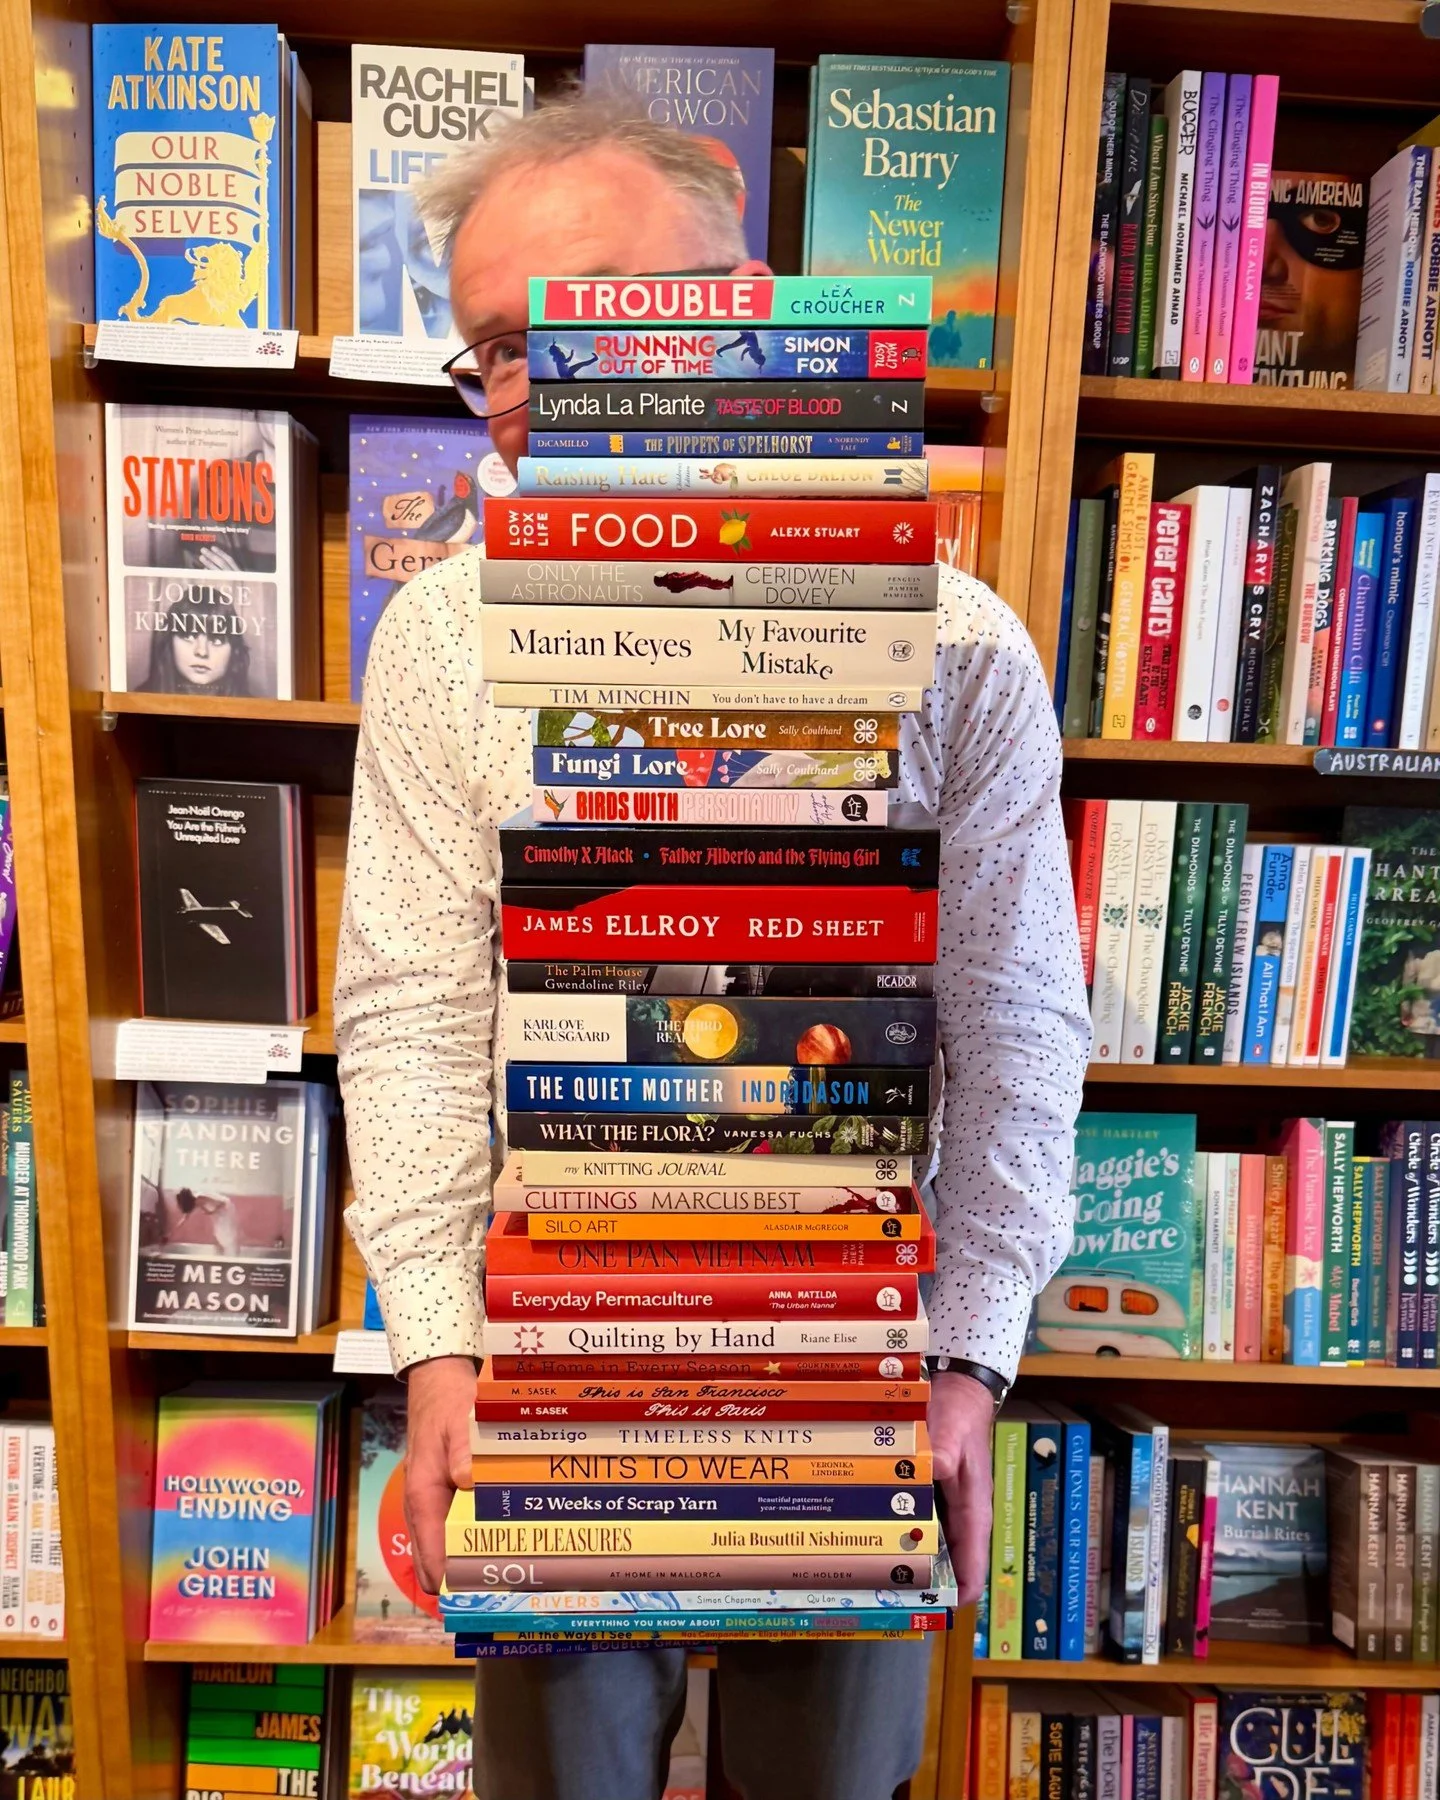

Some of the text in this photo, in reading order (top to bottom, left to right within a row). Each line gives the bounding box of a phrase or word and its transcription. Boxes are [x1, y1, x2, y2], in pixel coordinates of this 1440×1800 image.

[144, 36, 224, 72] KATE
[108, 75, 260, 111] ATKINSON
[359, 64, 518, 107] RACHEL
[828, 88, 996, 133] Sebastian
[383, 103, 493, 142] CUSK
[152, 136, 219, 160] OUR
[863, 138, 959, 190] Barry
[136, 172, 237, 198] NOBLE
[1247, 163, 1269, 229] IN BLOOM
[895, 195, 922, 211] The
[135, 210, 238, 235] SELVES
[868, 210, 944, 238] Newer
[868, 238, 942, 267] World
[1170, 172, 1189, 325] MICHAEL MOHAMMED AHMAD
[567, 283, 753, 317] TROUBLE
[791, 300, 884, 313] CROUCHER
[1398, 261, 1414, 359] ROBBIE ARNOTT
[785, 337, 850, 353] SIMON
[797, 358, 838, 373] FOX
[540, 392, 705, 419] Lynda La Plante
[645, 435, 813, 455] THE PUPPETS OF SPELHORST
[123, 455, 275, 524] STATIONS
[571, 513, 697, 548] FOOD
[771, 527, 860, 538] ALEXX STUART
[527, 564, 625, 581] ONLY THE
[1248, 485, 1274, 641] ZACHARY'S CRY
[746, 567, 855, 585] CERIDWEN
[148, 583, 252, 606] LOUISE
[511, 584, 643, 603] ASTRONAUTS
[766, 587, 834, 605] DOVEY
[134, 611, 267, 637] KENNEDY
[719, 619, 866, 643] My Favourite
[510, 629, 692, 665] Marian Keyes
[742, 652, 833, 681] Mistake
[550, 689, 691, 705] TIM MINCHIN
[713, 694, 868, 705] You don't have to have a dream
[649, 716, 766, 739] Tree Lore
[779, 724, 841, 736] Sally Coulthard
[552, 753, 688, 779] Fungi Lore
[577, 792, 799, 823] BIRDS WITH PERSONALITY
[523, 915, 720, 937] JAMES ELLROY
[749, 919, 884, 937] RED SHEET
[545, 965, 642, 976] The Palm House
[877, 975, 917, 988] PICADOR
[1262, 962, 1274, 978] All
[545, 979, 648, 992] Gwendoline Riley
[1258, 981, 1272, 1009] That
[1166, 982, 1181, 1036] FRENCH
[1178, 986, 1192, 1032] JACKIE
[523, 1019, 584, 1030] KARL OVE
[1256, 1015, 1268, 1037] Am
[523, 1031, 610, 1042] KNAUSGAARD
[527, 1076, 724, 1102] THE QUIET MOTHER
[540, 1124, 715, 1142] WHAT THE FLORA?
[177, 1150, 261, 1169] THERE
[564, 1162, 727, 1176] my KNITTING JOURNAL
[526, 1191, 801, 1210] CUTTINGS MARCUS BEST
[1331, 1132, 1346, 1253] SALLY HEPWORTH
[12, 1141, 30, 1290] MURDER AT THORNWOOD PARK
[1074, 1189, 1164, 1225] Going
[545, 1220, 617, 1233] SILO ART
[1068, 1225, 1178, 1257] owhere
[182, 1265, 248, 1285] MEG
[156, 1290, 269, 1312] MASON
[512, 1291, 713, 1311] Everyday Permaculture
[568, 1327, 775, 1352] Quilting by Hand
[801, 1332, 857, 1343] Riane Elise
[498, 1429, 587, 1443] malabrigo
[619, 1429, 813, 1445] TIMELESS KNITS
[551, 1456, 789, 1480] KNITS TO WEAR
[164, 1475, 305, 1497] HOLLYWOOD,
[1218, 1474, 1320, 1497] HANNAH
[179, 1497, 292, 1520] ENDING
[525, 1496, 717, 1515] 52 Weeks of Scrap Yarn
[1236, 1500, 1299, 1521] KENT
[464, 1527, 632, 1552] SIMPLE PLEASURES
[711, 1530, 883, 1547] Julia Busuttil Nishimura
[1224, 1525, 1311, 1542] Burial Rites
[184, 1547, 270, 1570] JOHN
[179, 1574, 276, 1598] GREEN
[483, 1564, 543, 1585] SOL
[364, 1687, 421, 1725] The
[256, 1715, 321, 1741] JAMES
[375, 1730, 473, 1761] World
